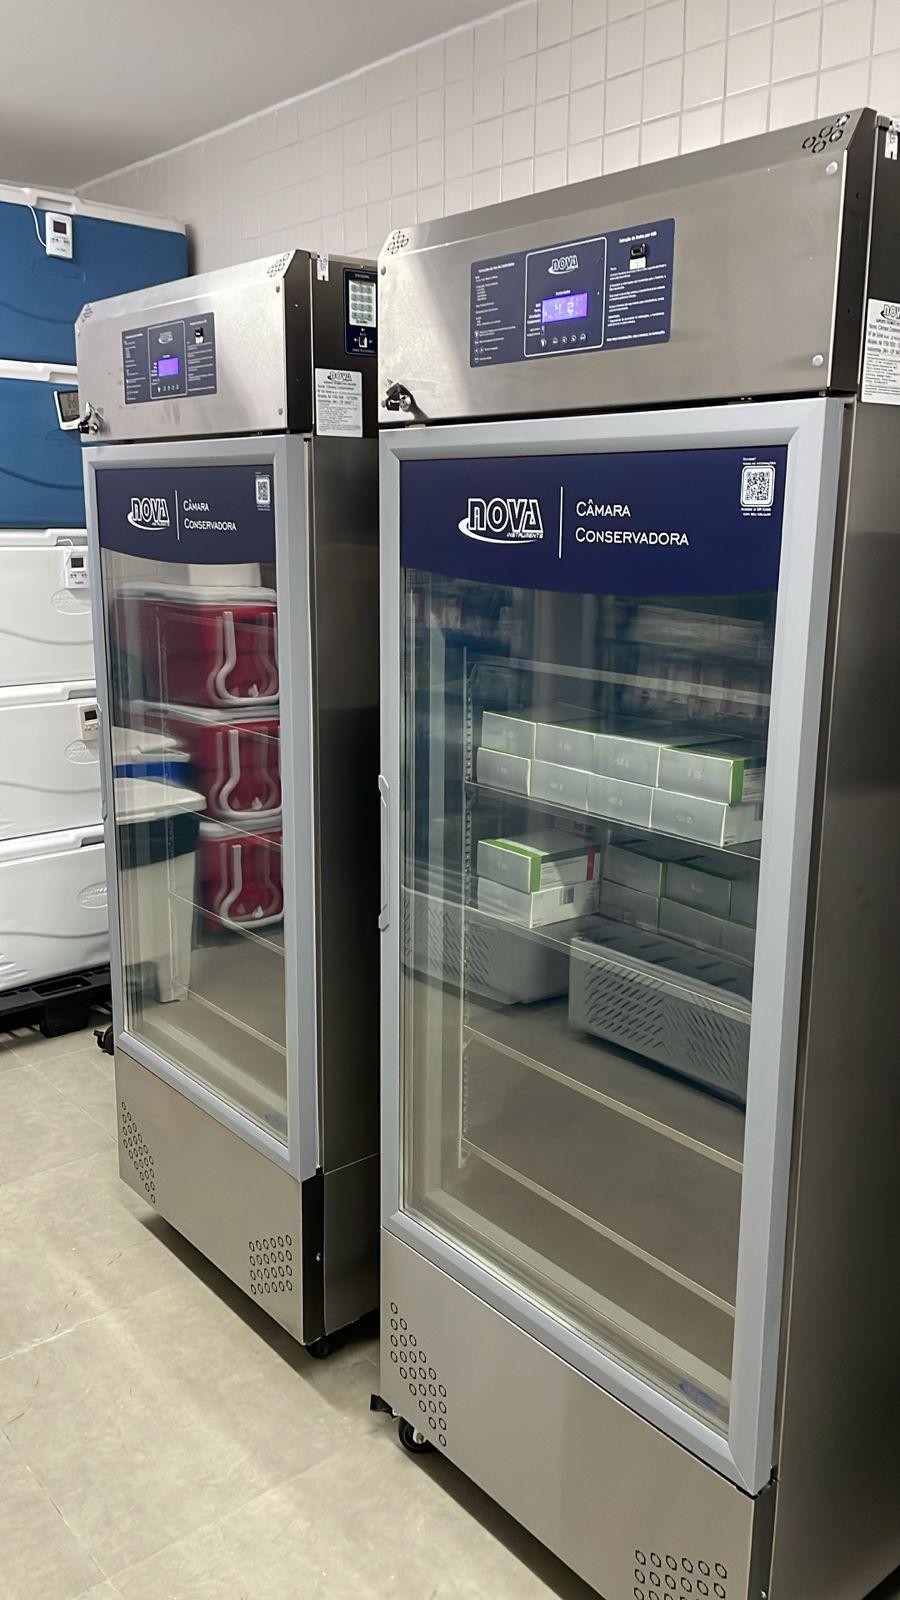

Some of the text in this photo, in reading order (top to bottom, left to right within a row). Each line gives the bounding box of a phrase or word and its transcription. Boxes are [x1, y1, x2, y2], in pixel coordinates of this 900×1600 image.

[551, 254, 579, 271] NOVA
[884, 304, 900, 317] NO
[131, 497, 170, 522] NOVA
[183, 499, 210, 512] CÂMARA
[575, 499, 631, 517] CÂMARA
[468, 497, 544, 533] NOVA
[184, 518, 238, 531] CONSERVADORA
[575, 527, 690, 546] CONSERVADORA
